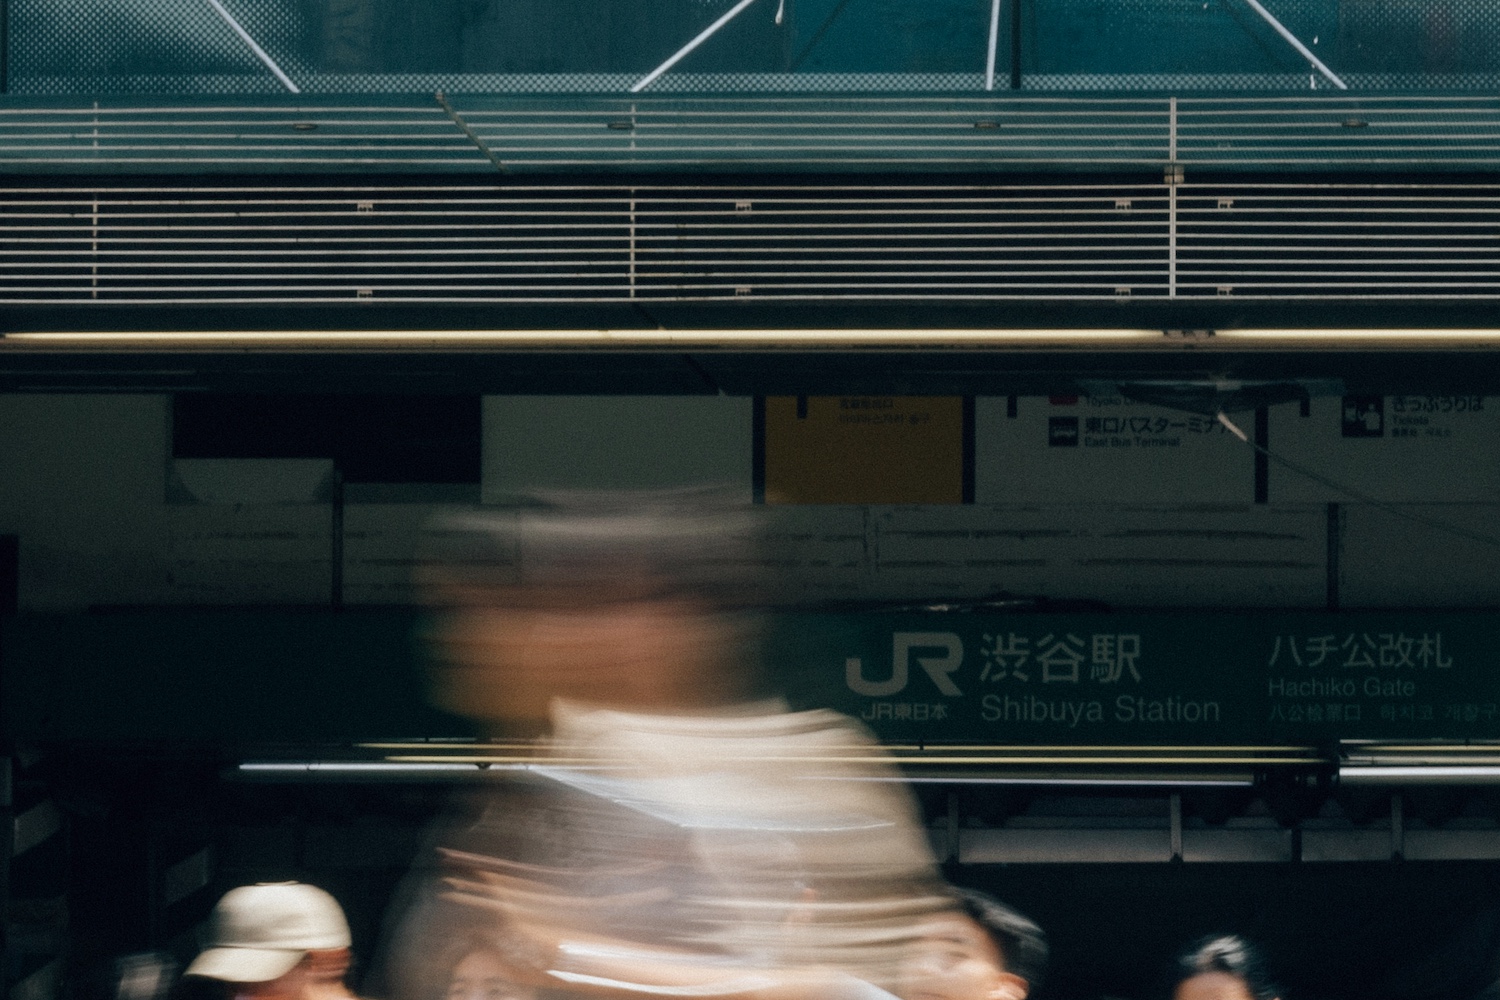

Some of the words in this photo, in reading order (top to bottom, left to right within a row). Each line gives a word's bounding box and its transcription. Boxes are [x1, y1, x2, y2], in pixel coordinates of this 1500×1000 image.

[1084, 436, 1108, 448] East
[1111, 436, 1131, 448] Bus
[1136, 436, 1180, 448] Terminal
[846, 632, 963, 697] JR
[979, 632, 1142, 684] 渋谷駅
[1268, 632, 1453, 669] ハチ公改札
[1363, 677, 1415, 697] Gate
[861, 702, 948, 722] JR東日本
[980, 694, 1103, 728] Shibuya
[1114, 695, 1221, 722] Station
